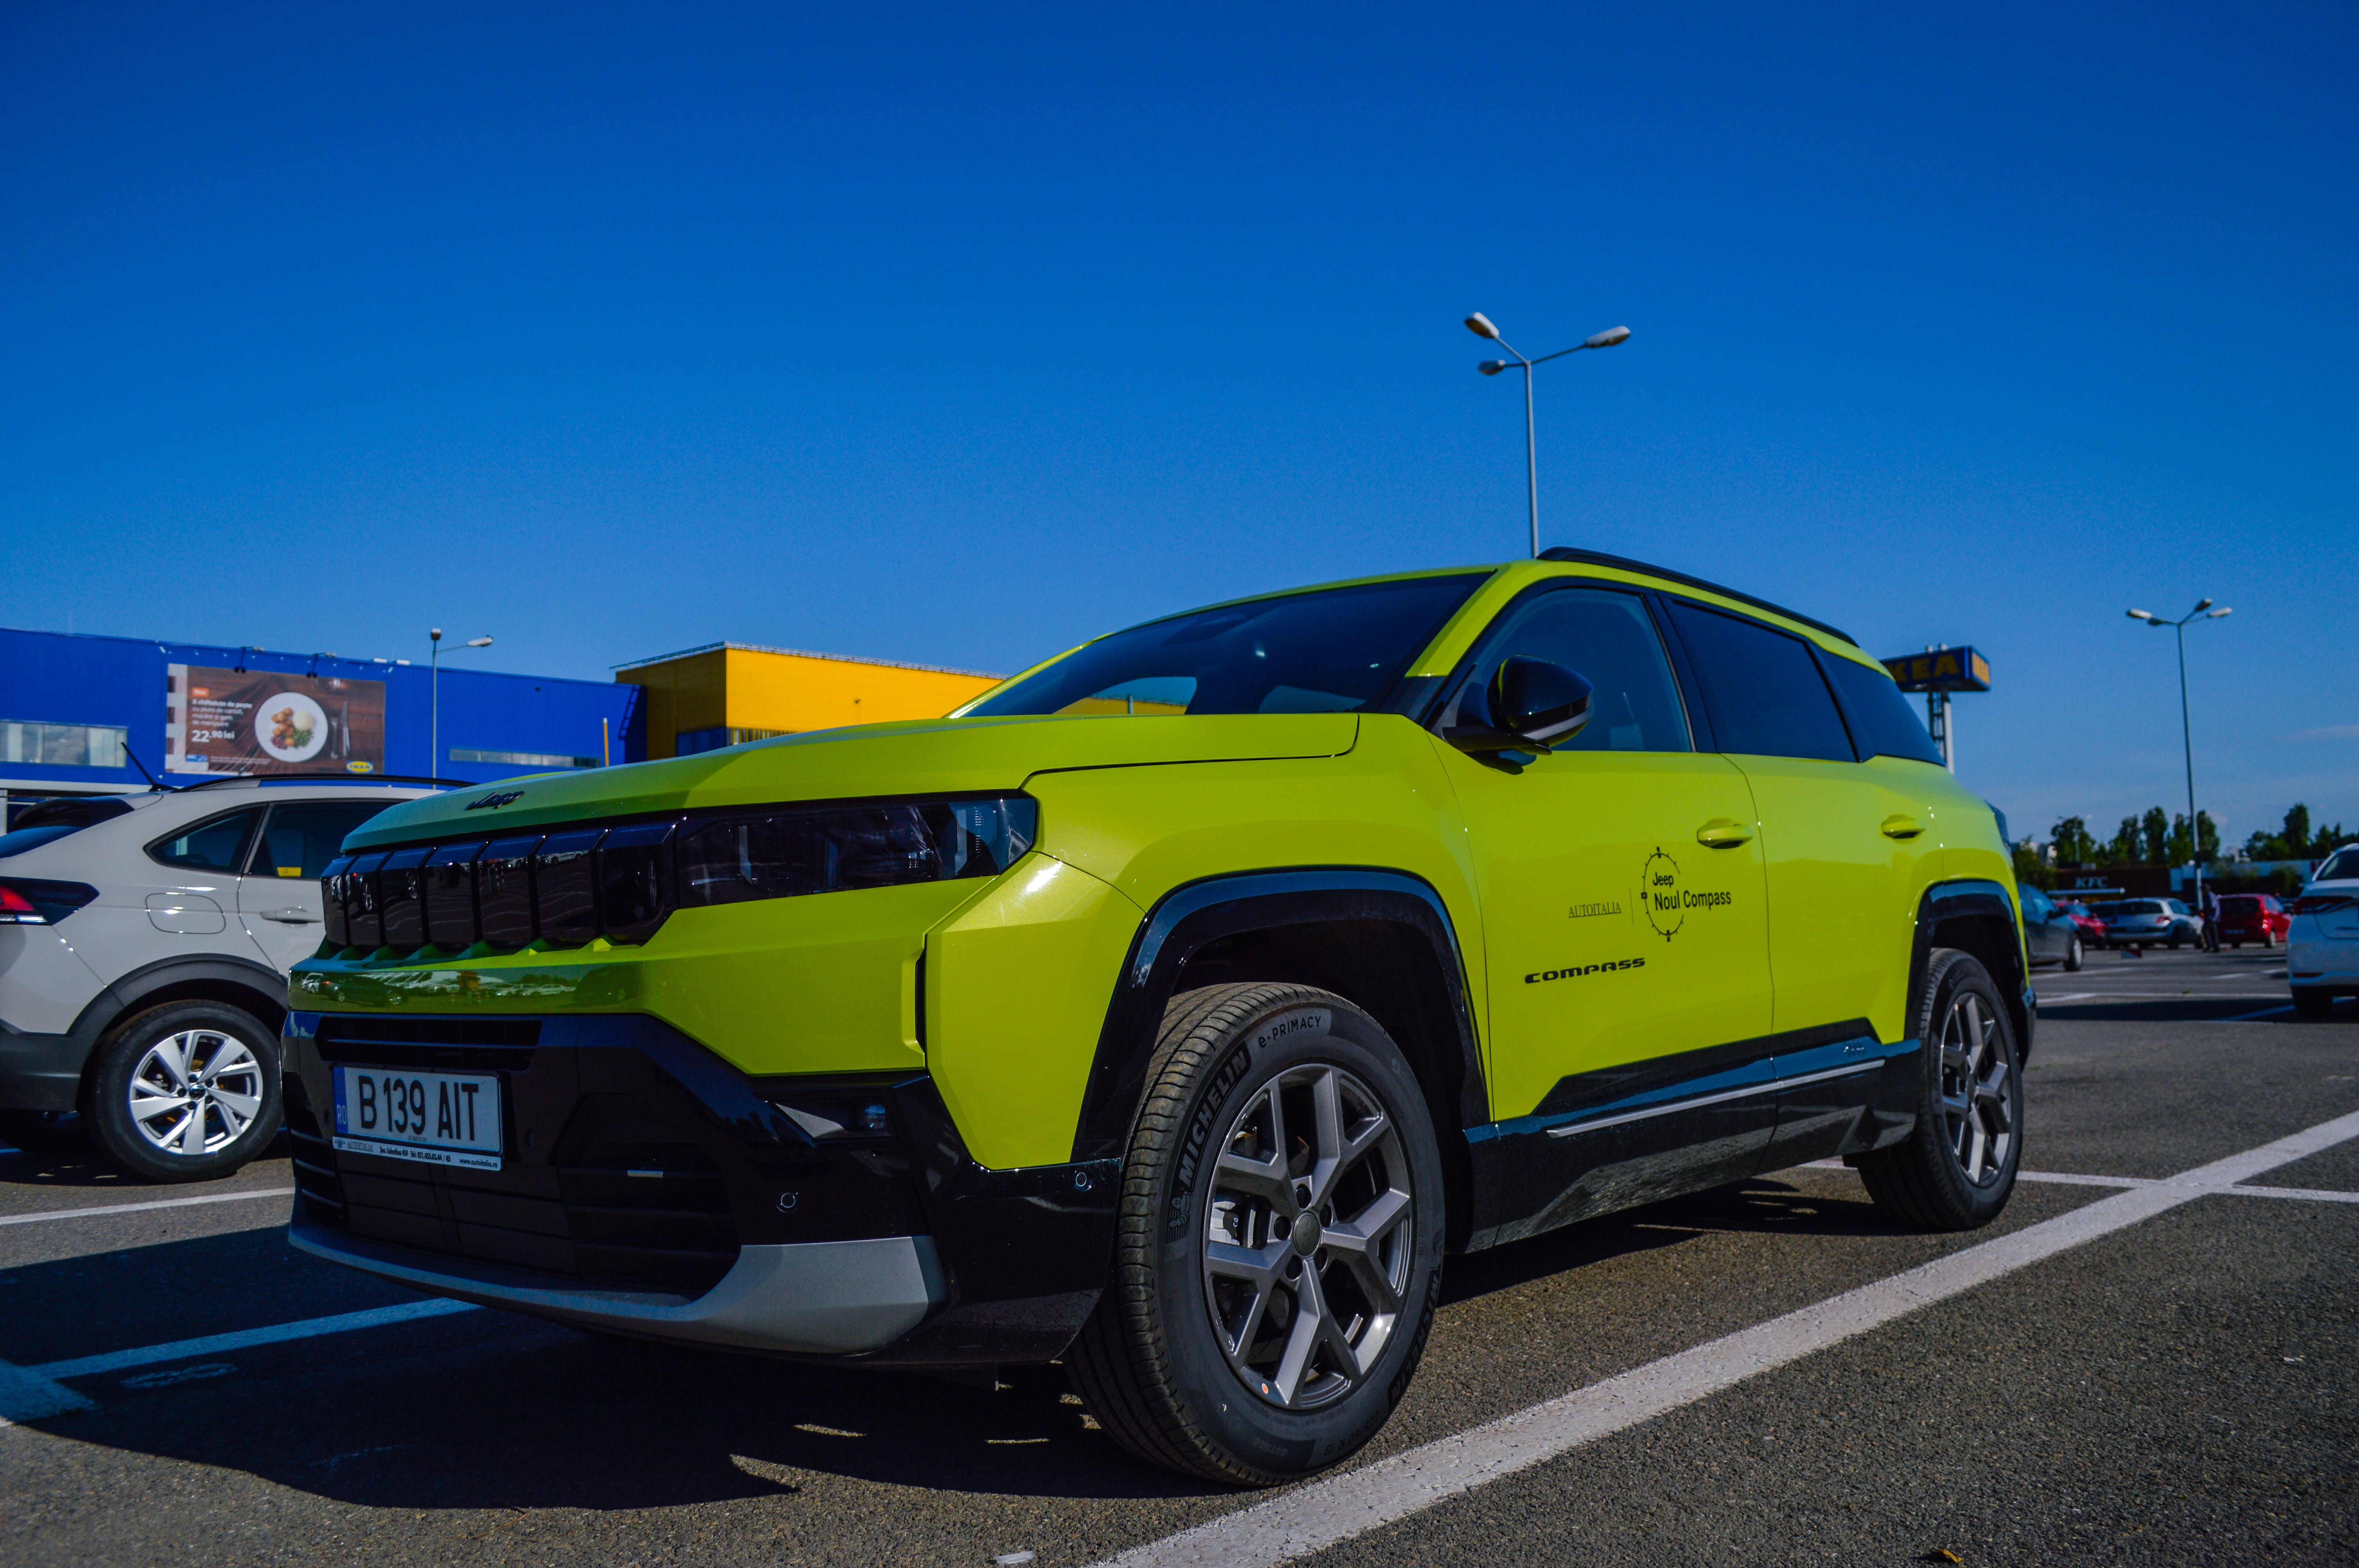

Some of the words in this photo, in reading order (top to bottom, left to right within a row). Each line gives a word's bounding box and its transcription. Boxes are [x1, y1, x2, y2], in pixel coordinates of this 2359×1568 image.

[1887, 654, 1960, 682] KEA
[224, 731, 235, 740] lei
[1652, 871, 1674, 887] Jeep
[2074, 876, 2108, 888] KFC
[1654, 890, 1681, 911] Noul
[1683, 891, 1732, 911] Compass
[1568, 902, 1622, 918] AUTOITALIA
[337, 1104, 347, 1125] RO
[358, 1076, 376, 1129] B
[383, 1078, 426, 1135] 139
[437, 1081, 479, 1141] AIT
[1179, 1050, 1247, 1188] MICHELIN
[347, 1141, 373, 1152] AUTOITALIA
[460, 1158, 498, 1168] www.autoitalia.ro
